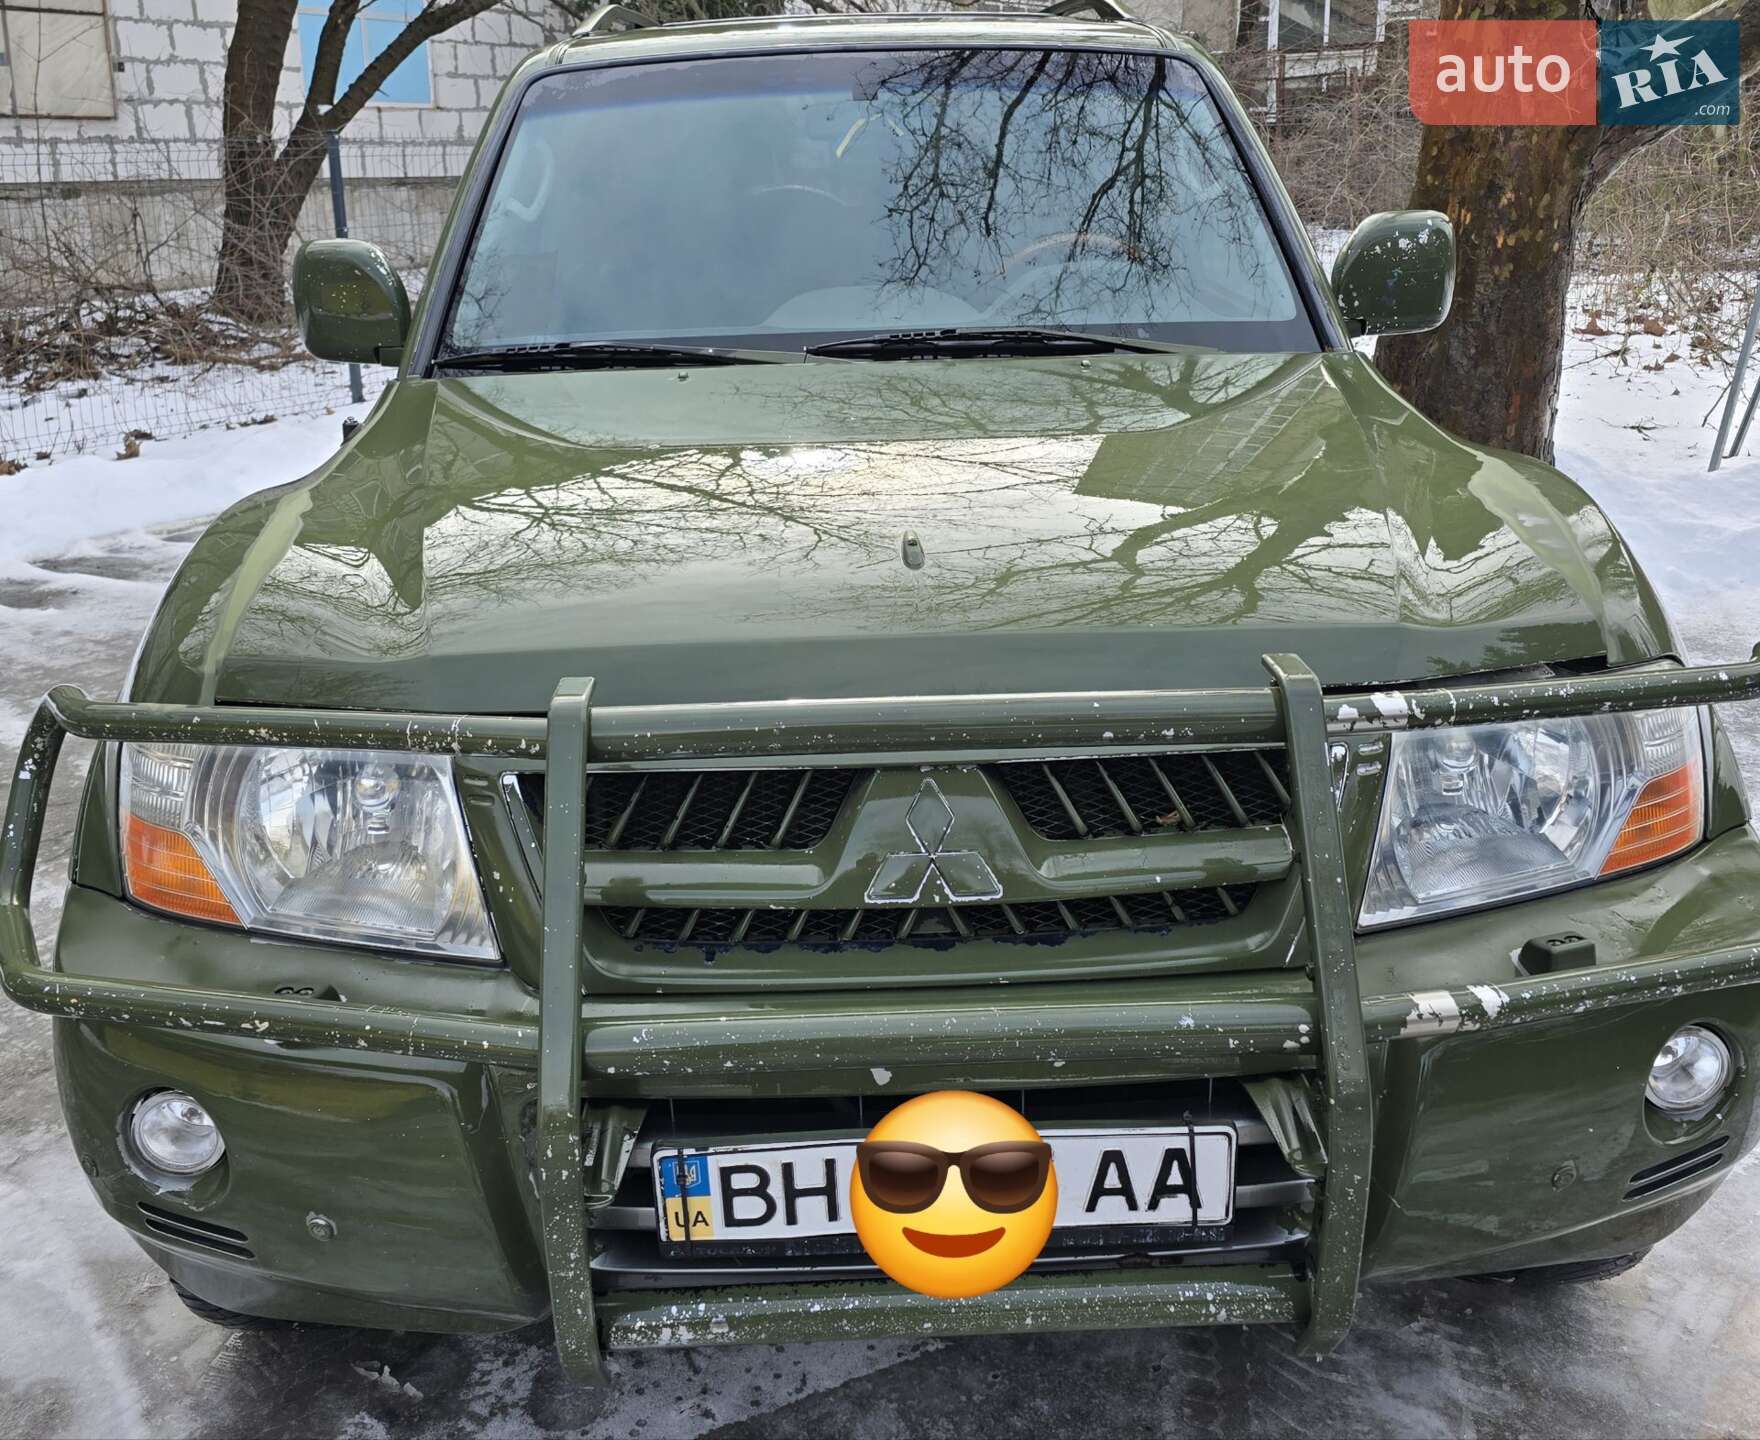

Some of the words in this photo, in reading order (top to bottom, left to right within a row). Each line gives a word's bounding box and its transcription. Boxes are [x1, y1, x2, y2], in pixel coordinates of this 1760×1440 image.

[719, 1158, 839, 1227] BH
[1085, 1148, 1202, 1212] AA
[674, 1211, 709, 1227] UA
